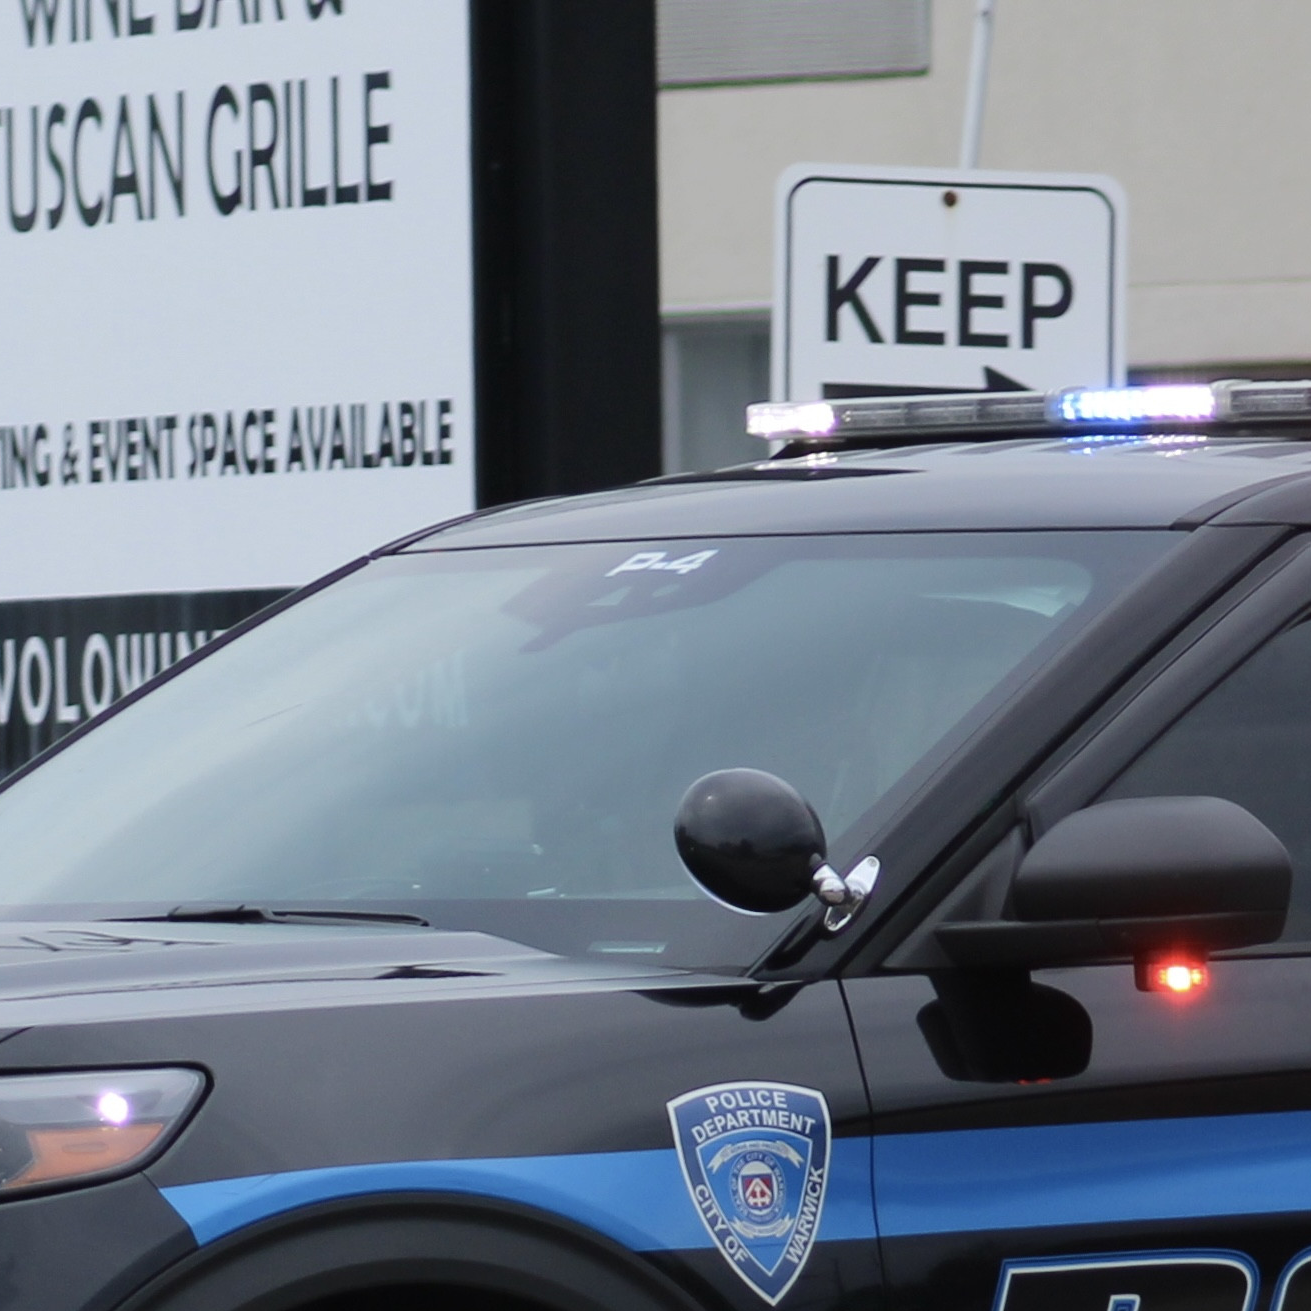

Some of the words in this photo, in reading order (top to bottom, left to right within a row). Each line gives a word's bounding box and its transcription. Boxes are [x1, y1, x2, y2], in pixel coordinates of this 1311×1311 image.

[204, 69, 395, 217] GRILLE
[824, 253, 1075, 351] KEEP
[61, 420, 81, 487] &
[88, 413, 179, 485] EVENT
[187, 407, 277, 477] SPACE
[286, 398, 454, 474] AVAILABLE
[604, 548, 720, 578] P-4
[691, 1109, 816, 1143] DEPARTMENT
[705, 1090, 787, 1113] POLICE
[695, 1184, 728, 1232] CITY
[723, 1235, 749, 1263] OF
[785, 1166, 824, 1265] WARWICK
